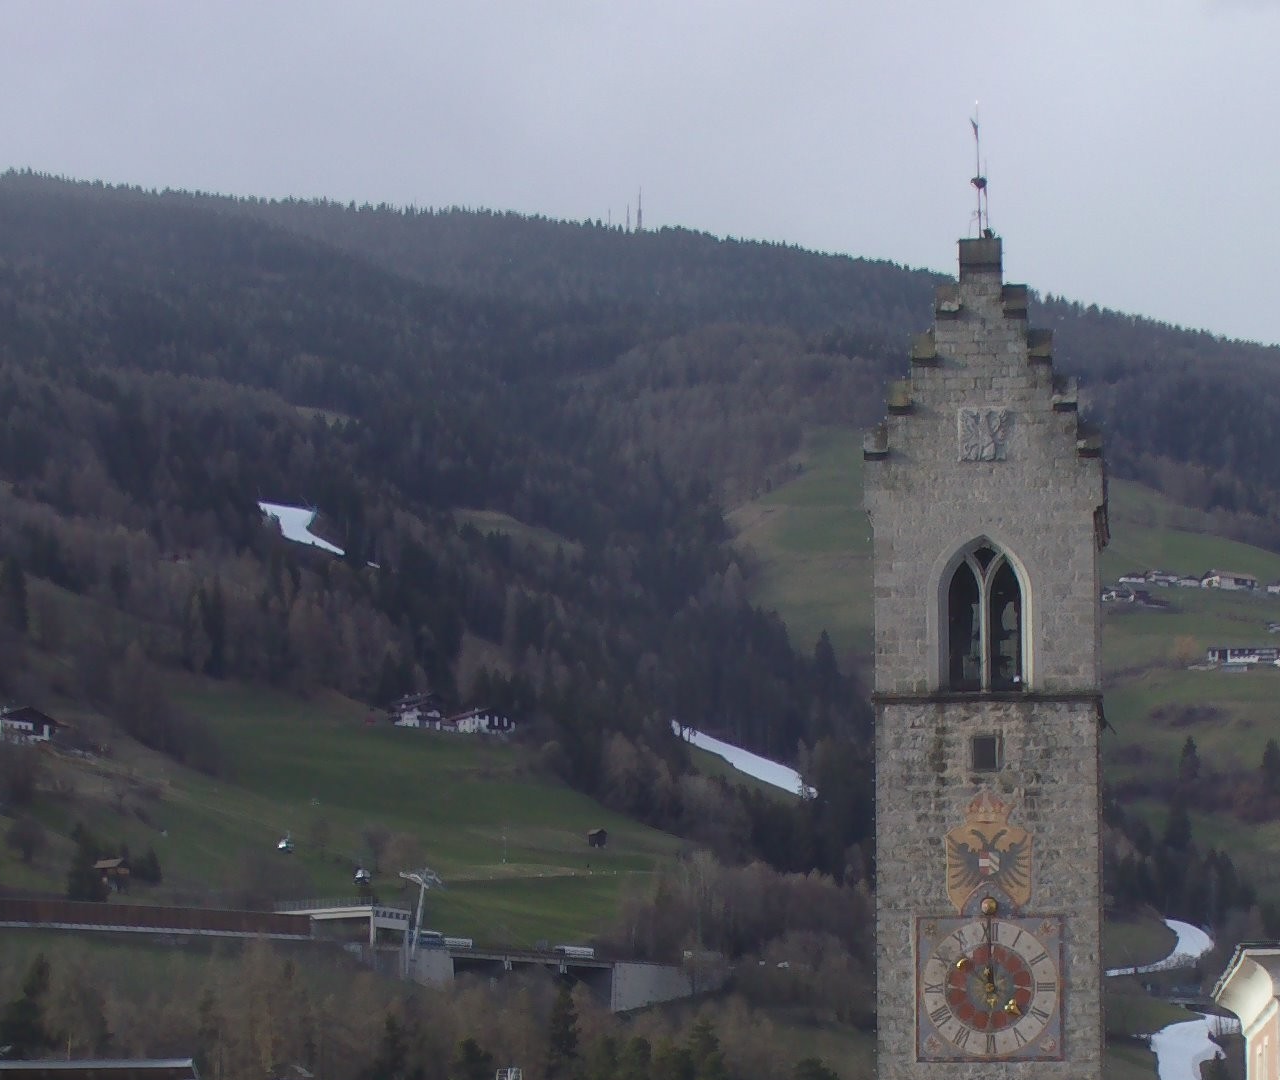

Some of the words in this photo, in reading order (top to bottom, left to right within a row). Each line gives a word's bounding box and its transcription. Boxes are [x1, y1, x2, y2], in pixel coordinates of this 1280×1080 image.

[1012, 929, 1022, 947] I
[1029, 952, 1048, 966] II
[925, 982, 943, 993] IX
[1037, 981, 1055, 993] III
[986, 1034, 996, 1053] VI
[1013, 1027, 1027, 1047] V
